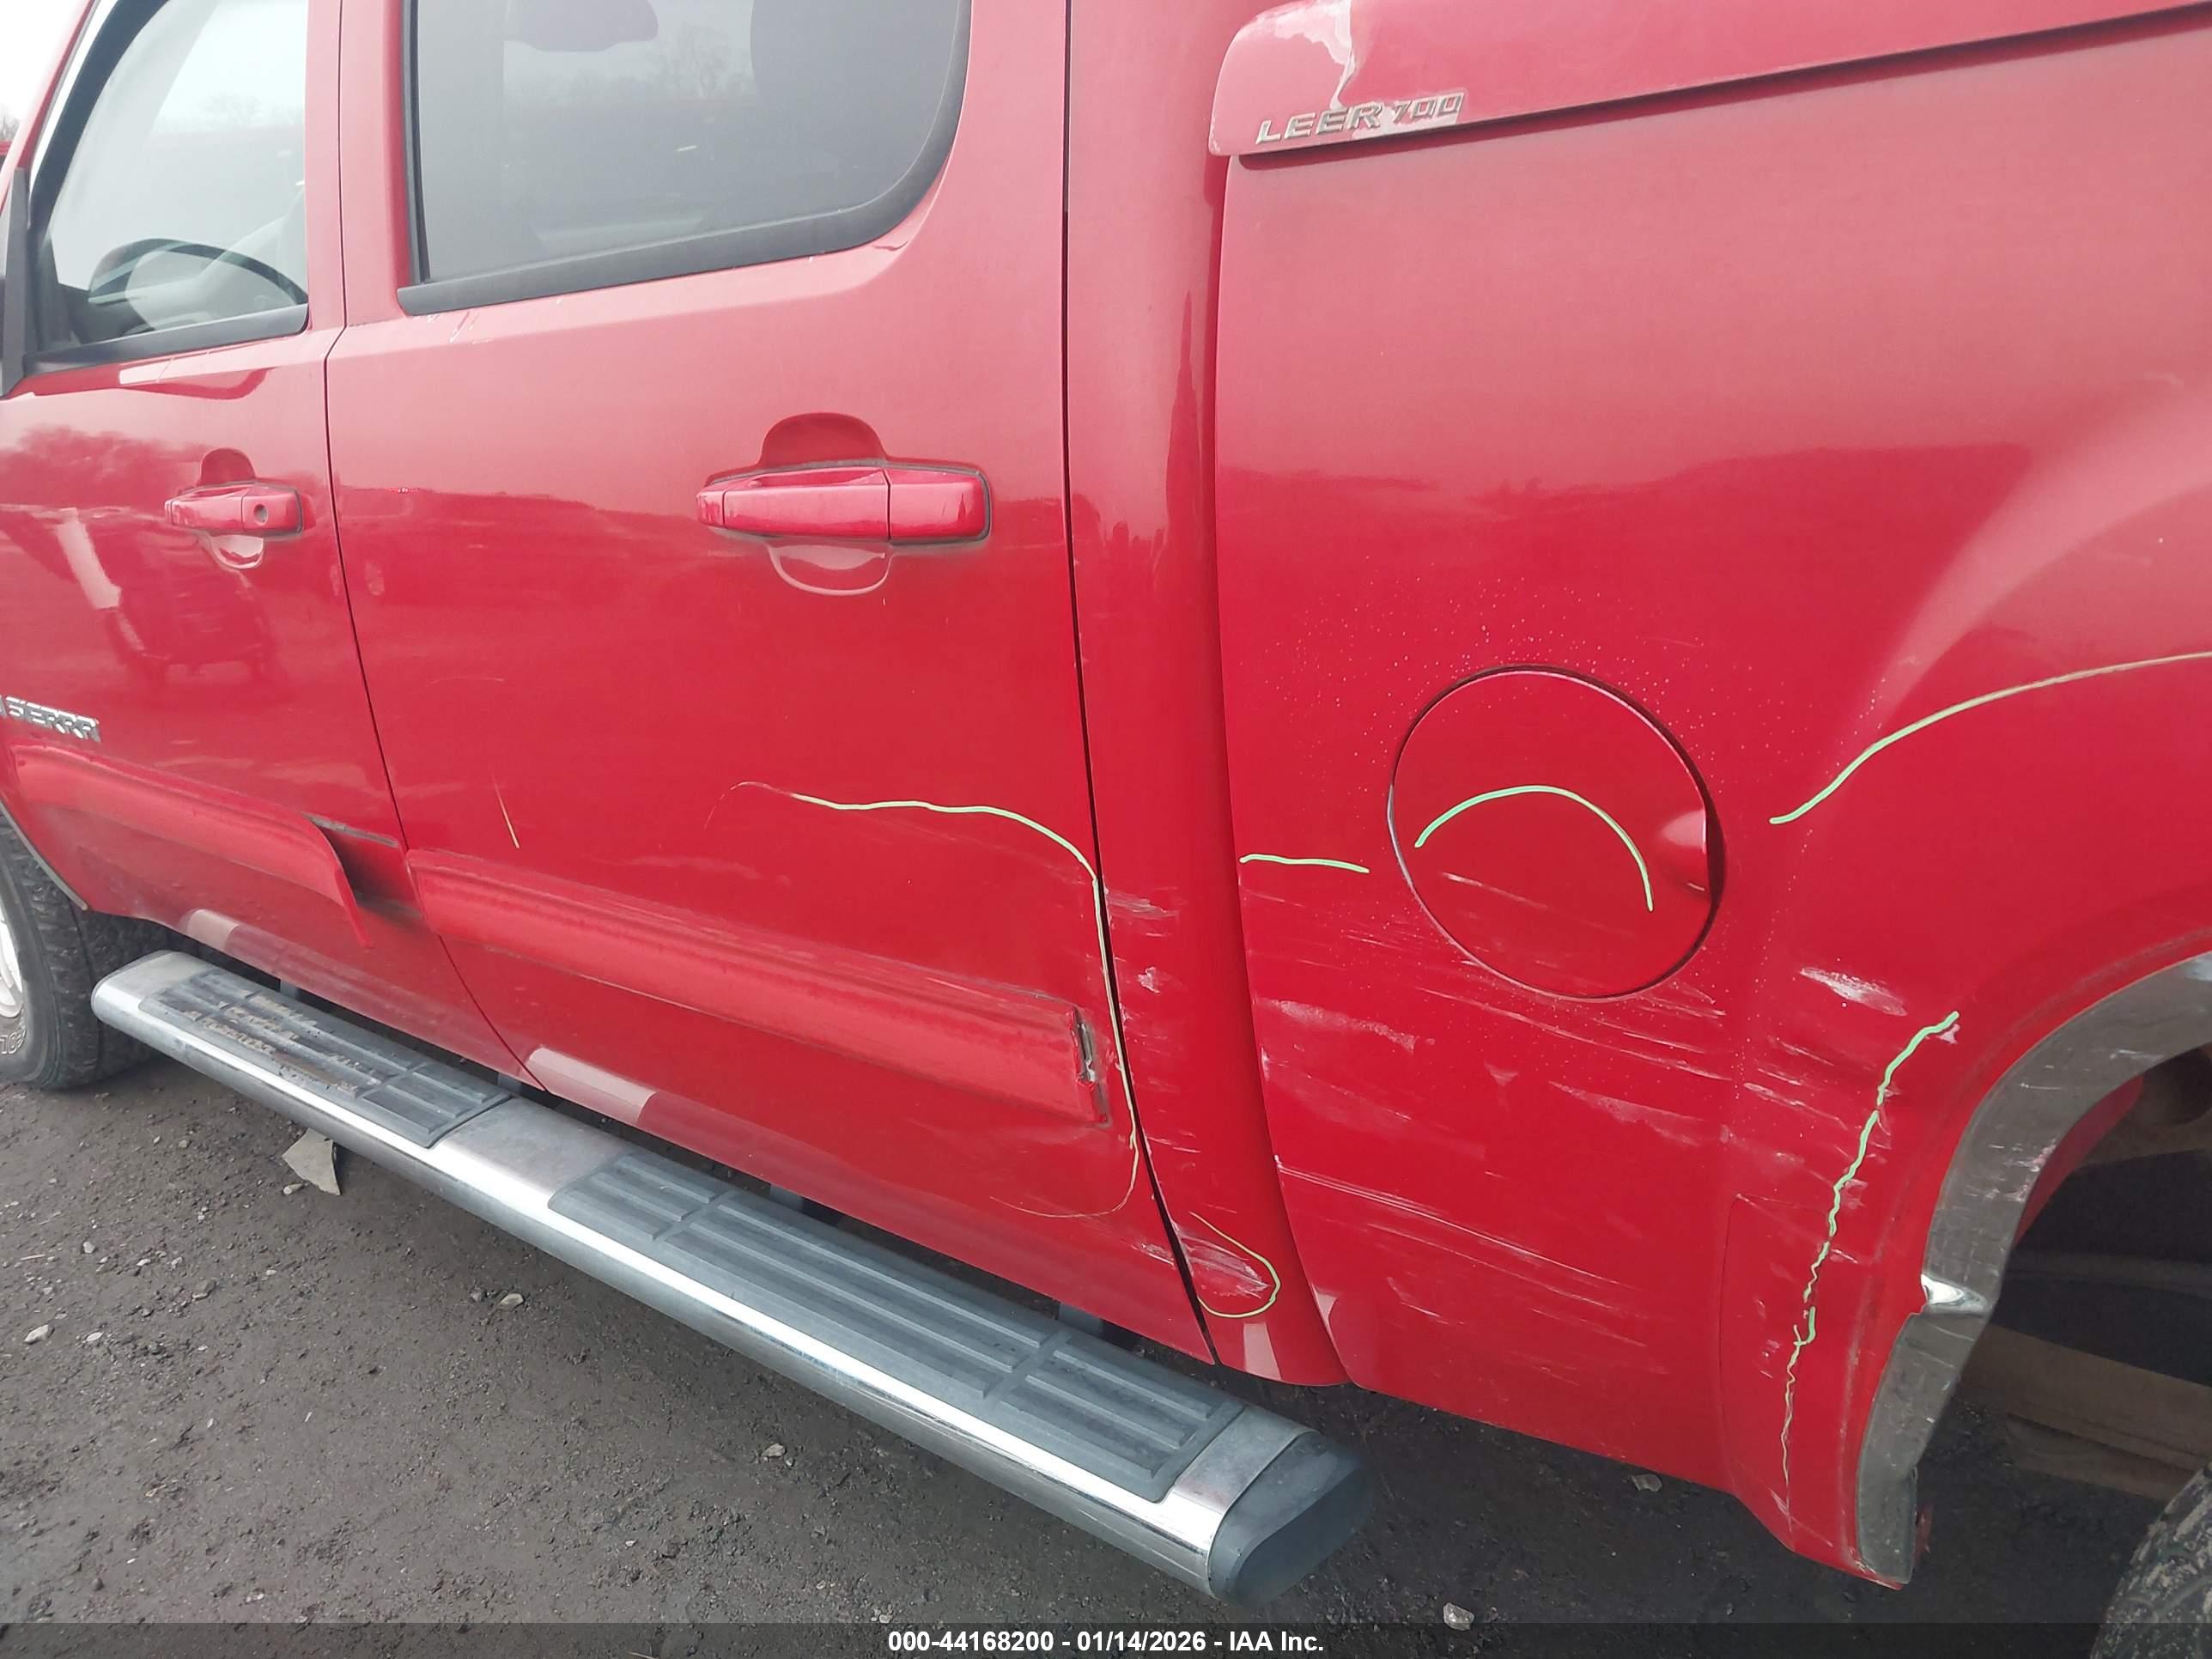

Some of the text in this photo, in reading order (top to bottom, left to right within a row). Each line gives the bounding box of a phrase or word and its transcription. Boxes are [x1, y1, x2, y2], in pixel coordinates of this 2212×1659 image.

[1255, 91, 1465, 144] LEER 700
[5, 695, 101, 744] SIERRA
